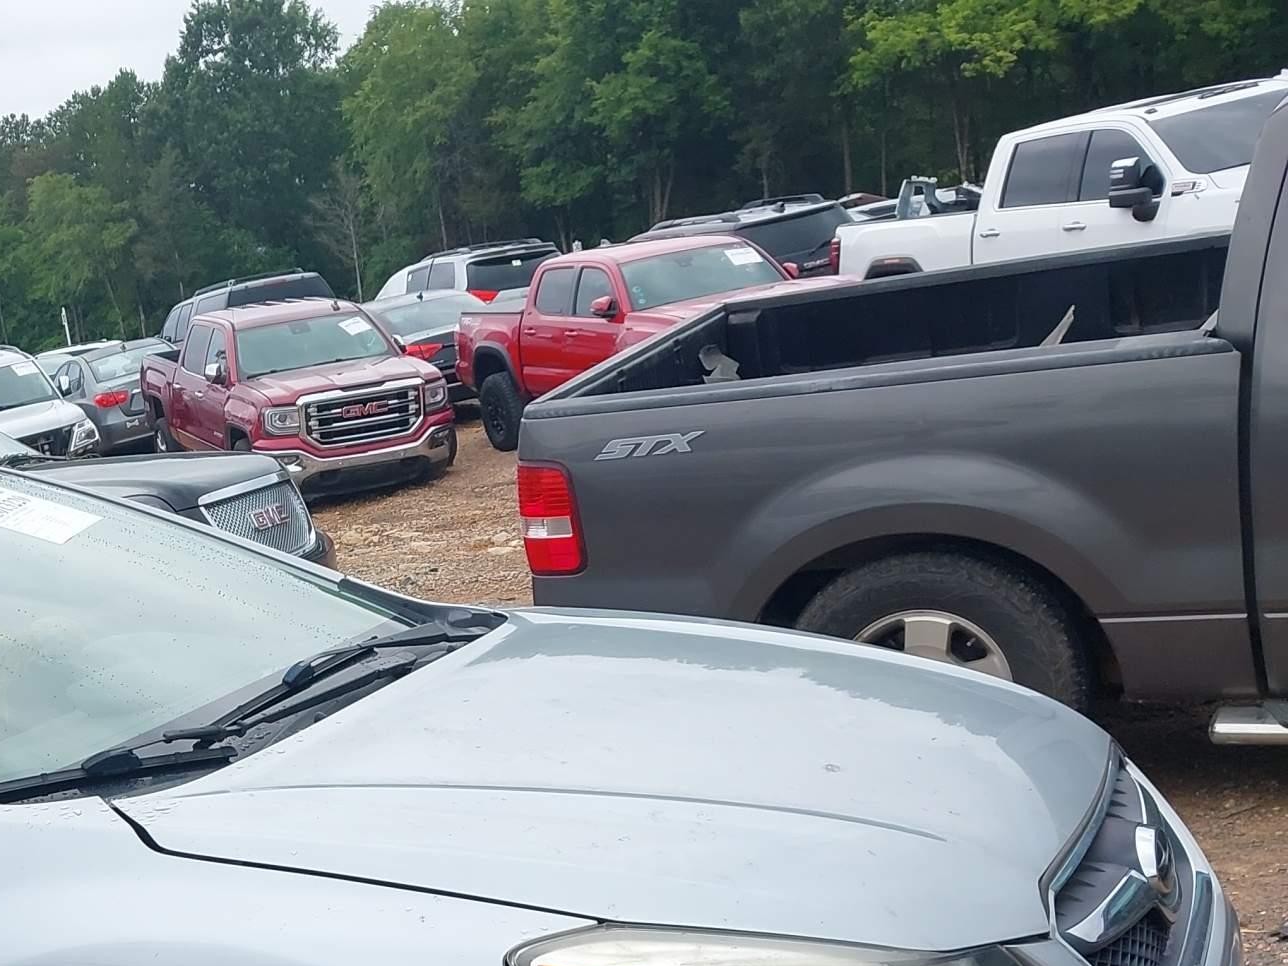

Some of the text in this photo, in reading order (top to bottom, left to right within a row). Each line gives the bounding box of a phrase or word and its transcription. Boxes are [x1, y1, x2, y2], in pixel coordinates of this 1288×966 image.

[341, 400, 389, 418] GMC
[593, 430, 706, 461] STX
[248, 504, 290, 530] GMC
